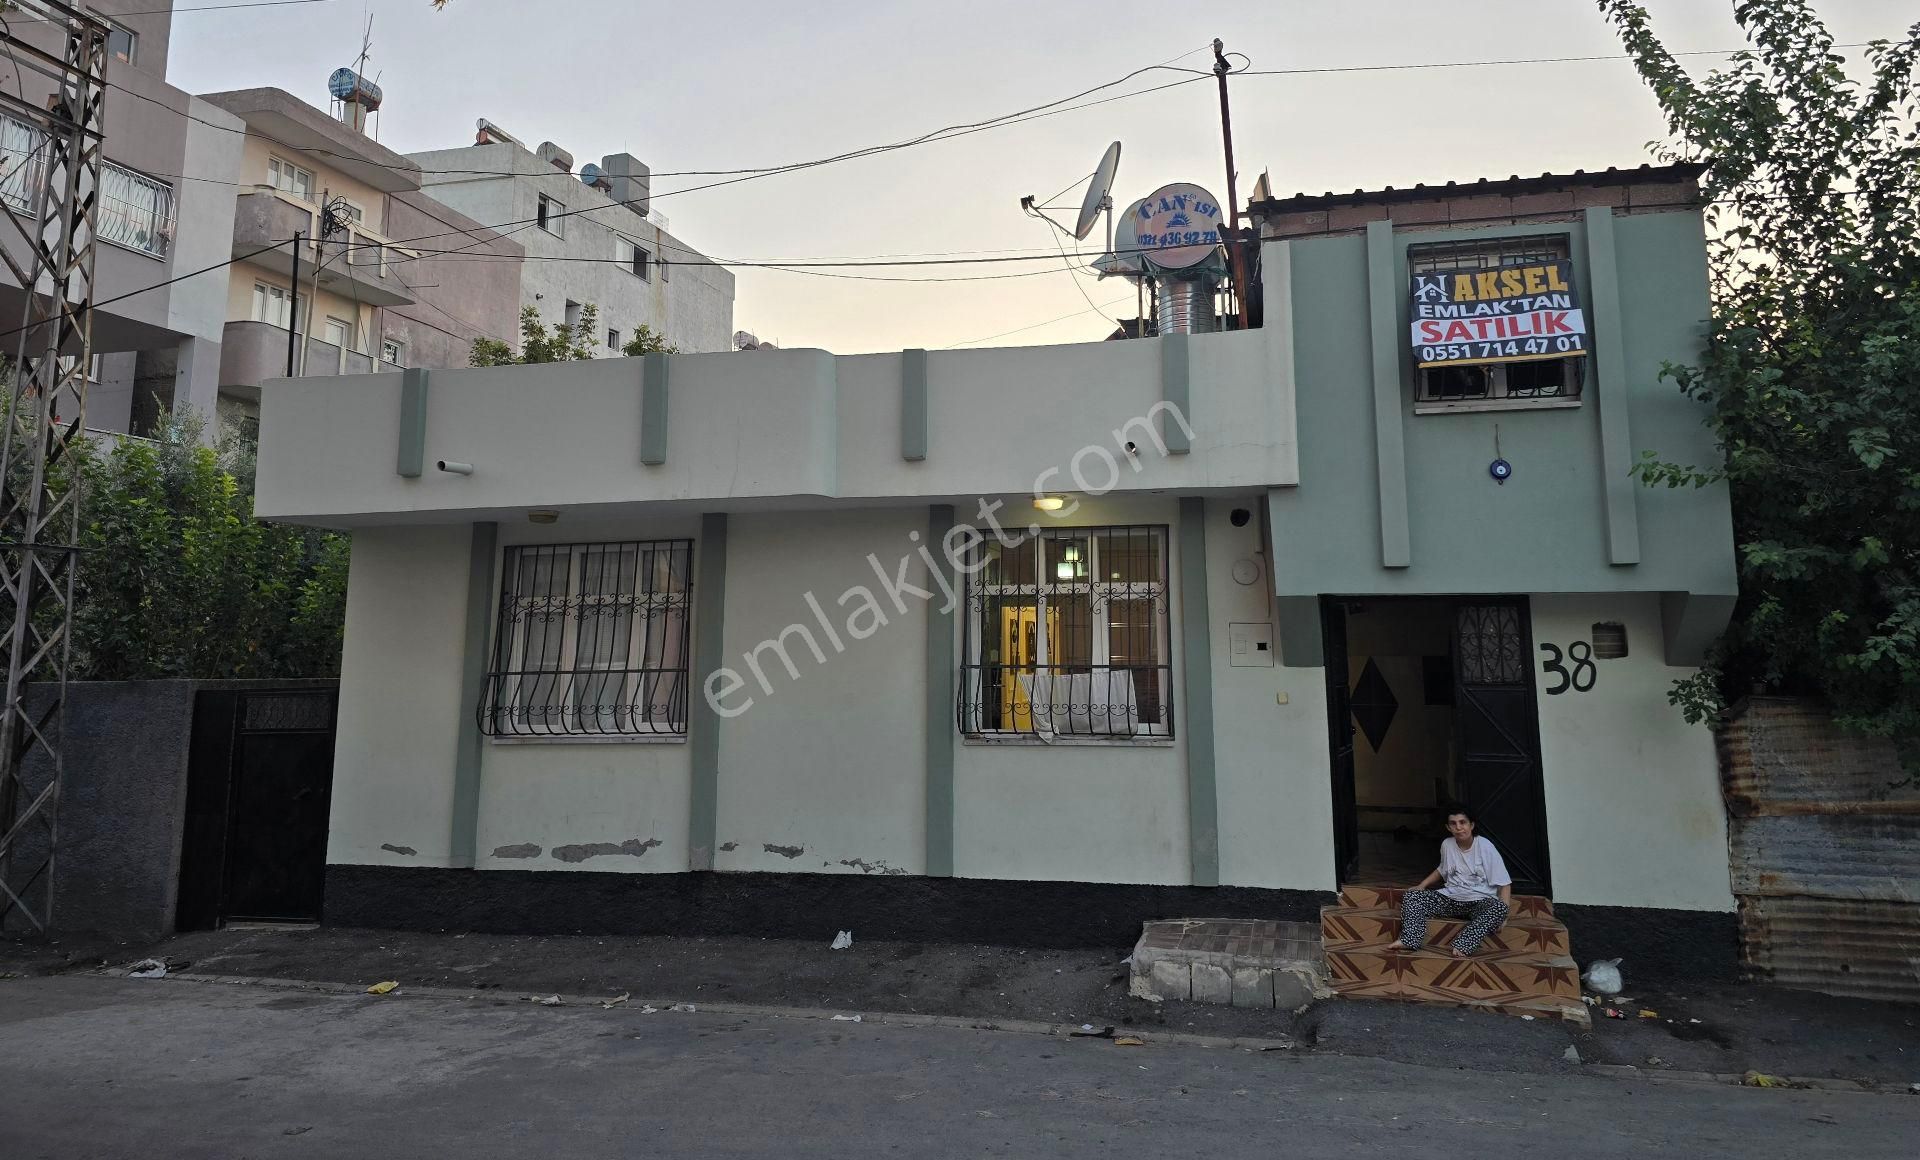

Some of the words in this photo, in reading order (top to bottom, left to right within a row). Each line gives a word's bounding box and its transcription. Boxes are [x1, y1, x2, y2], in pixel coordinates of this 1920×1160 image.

[1453, 265, 1569, 302] AKSEL
[1419, 294, 1571, 318] EMLAK'TAN
[1420, 311, 1574, 344] SATILIK
[1422, 344, 1471, 362] 0551
[1478, 341, 1519, 359] 714
[1524, 339, 1548, 354] 47
[1556, 335, 1582, 352] 01
[1540, 641, 1597, 695] 38
